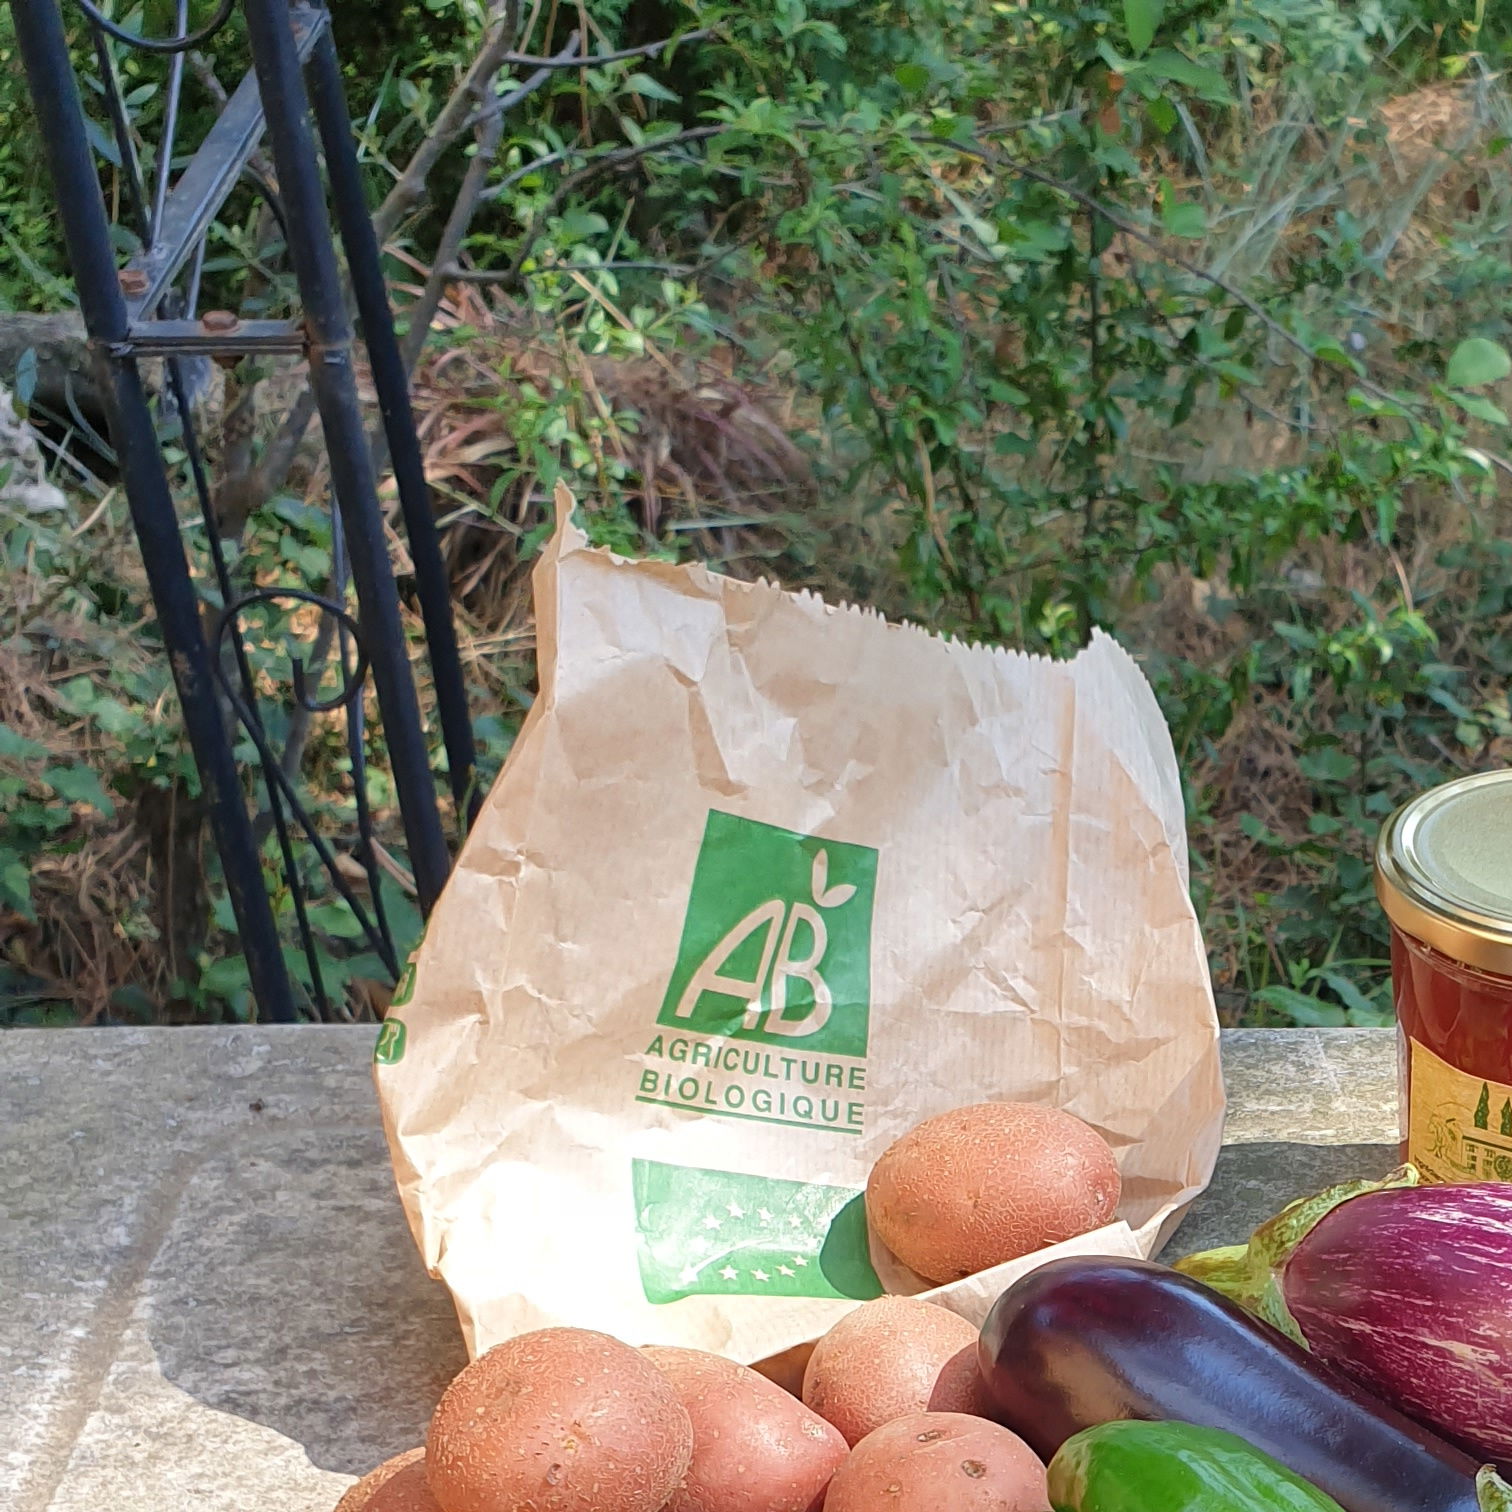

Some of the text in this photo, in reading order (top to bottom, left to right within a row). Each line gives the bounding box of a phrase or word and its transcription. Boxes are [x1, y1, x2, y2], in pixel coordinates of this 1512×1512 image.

[676, 899, 832, 1037] AB
[645, 1034, 868, 1091] AGRICULTURE
[639, 1068, 865, 1126] BIOLOGIQUE
